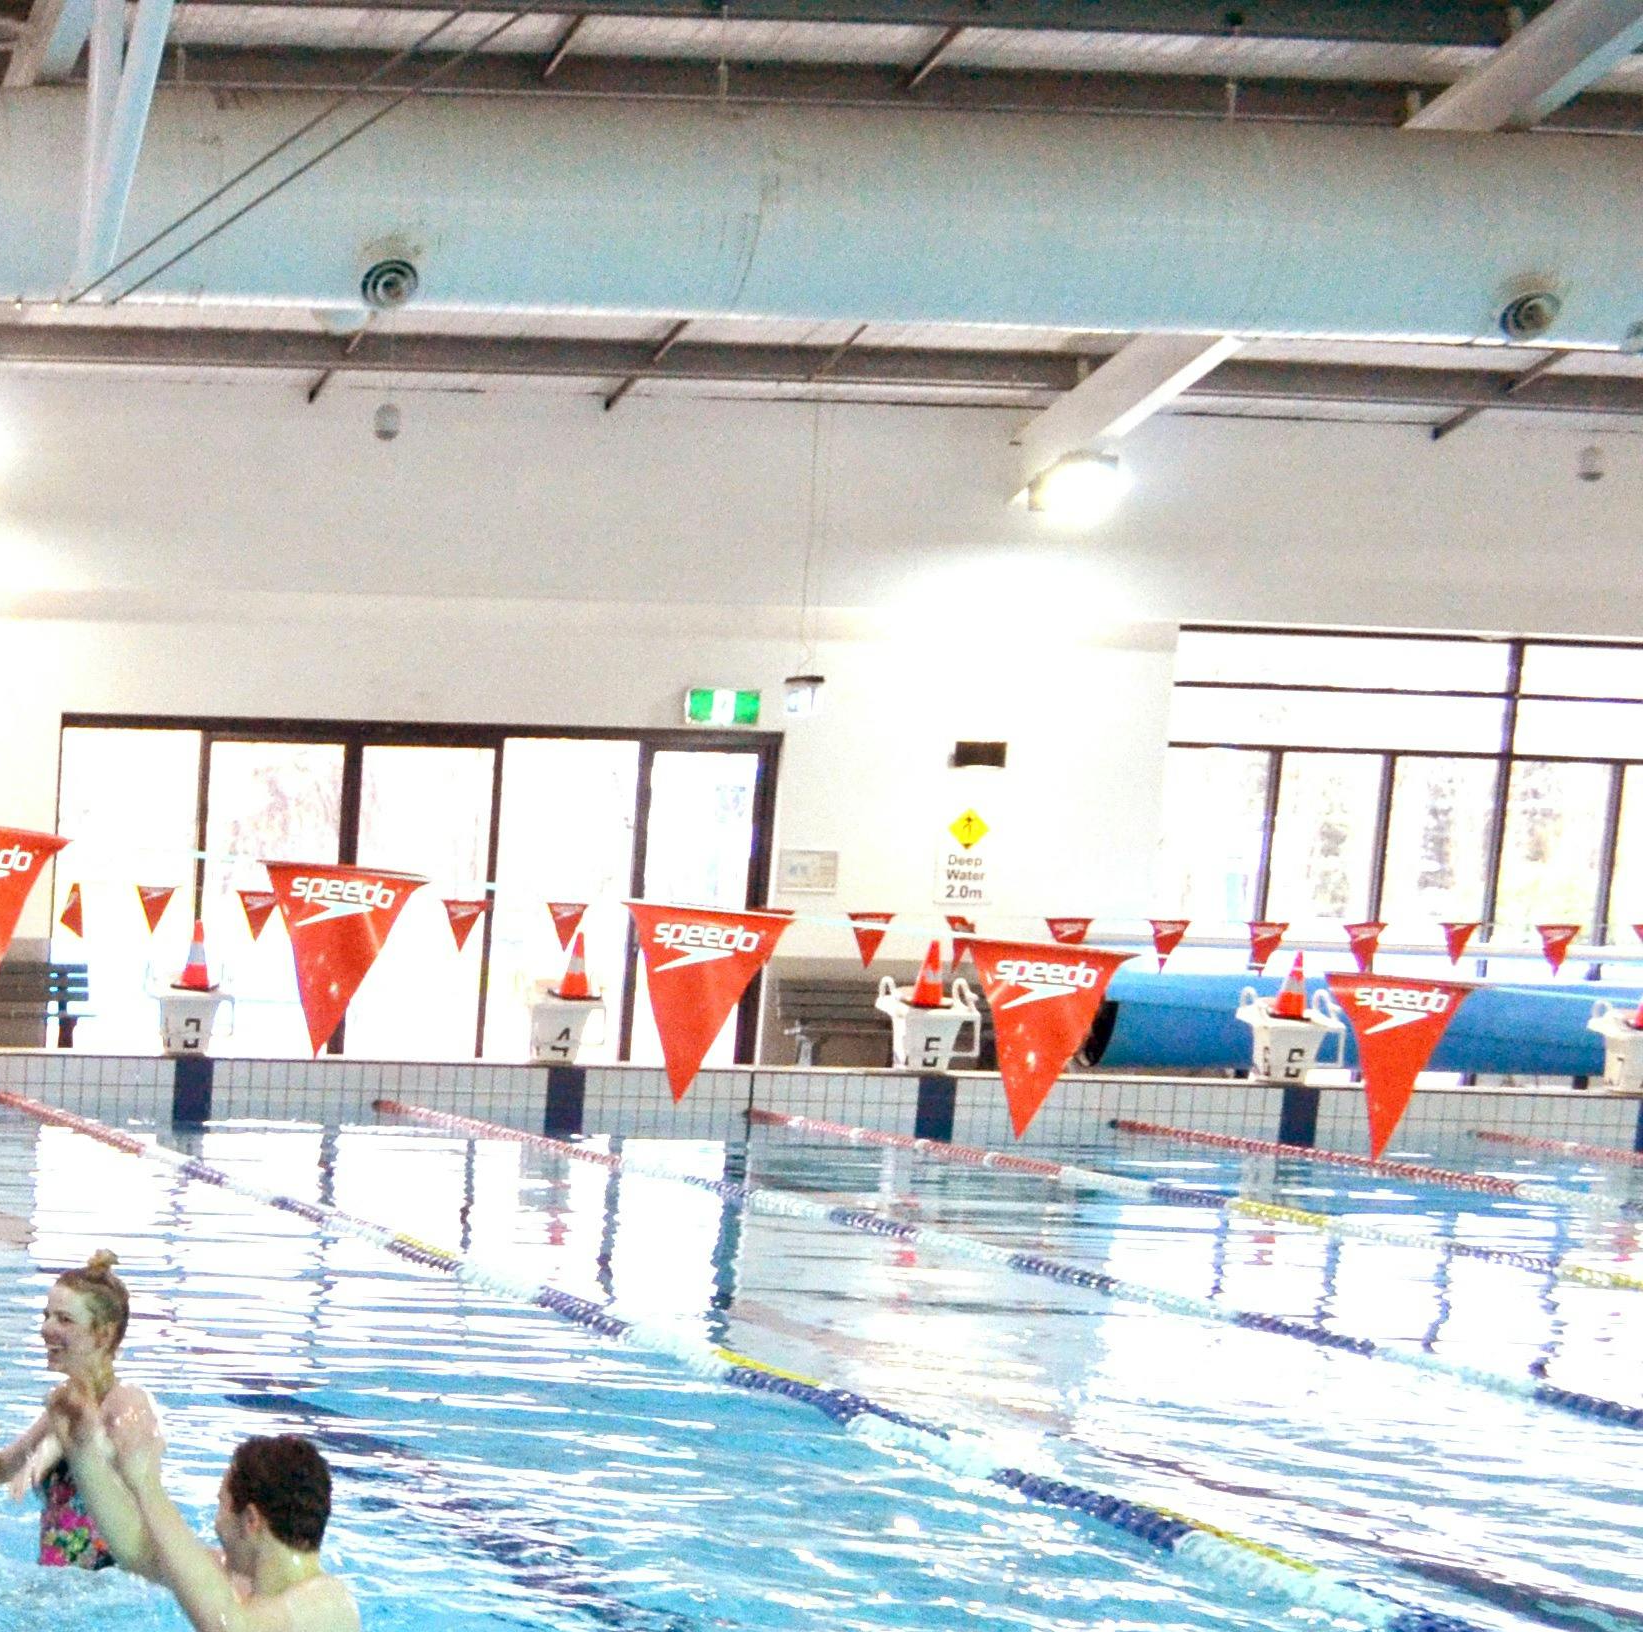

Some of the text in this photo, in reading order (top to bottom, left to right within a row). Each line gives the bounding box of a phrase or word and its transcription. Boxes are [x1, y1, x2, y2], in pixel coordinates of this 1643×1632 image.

[948, 854, 982, 867] Deep
[946, 869, 985, 881] Water
[290, 876, 397, 910] speedo
[945, 884, 983, 899] 2.0m
[653, 922, 758, 954] speedo
[994, 960, 1101, 989] speedo
[1355, 986, 1449, 1013] speedo
[550, 1027, 571, 1057] 4
